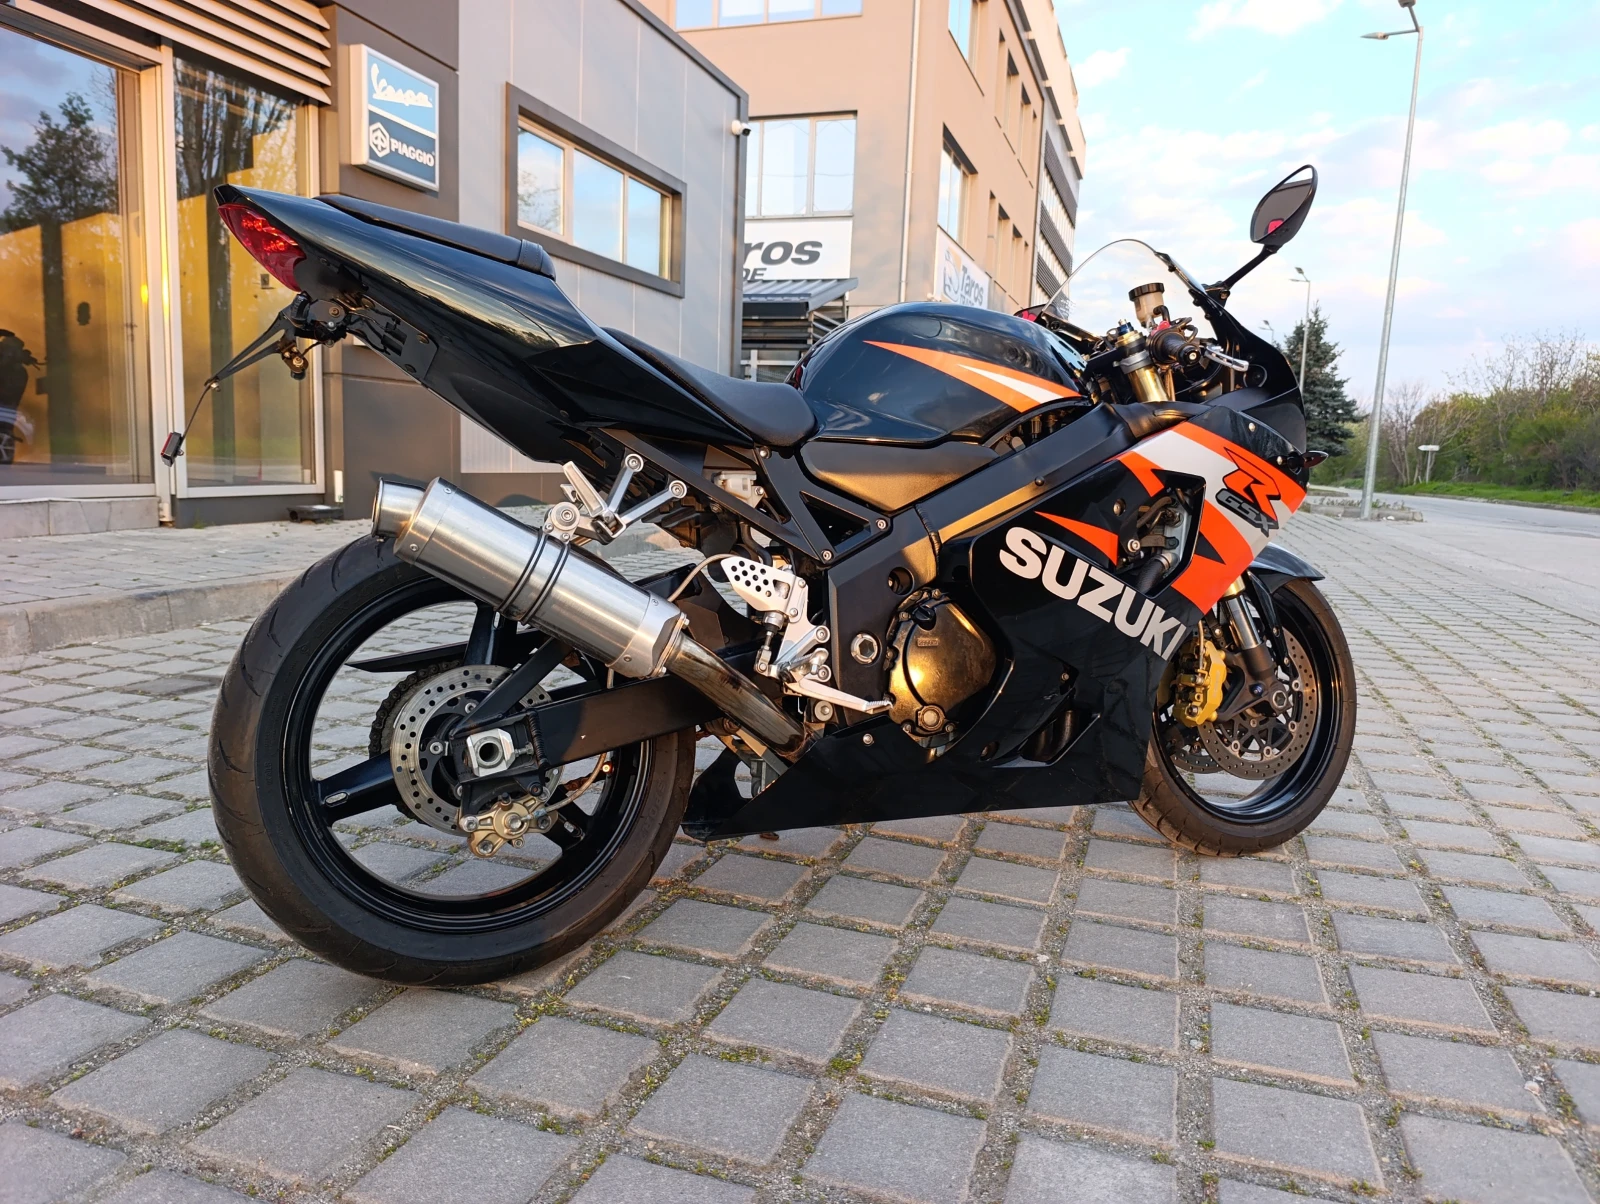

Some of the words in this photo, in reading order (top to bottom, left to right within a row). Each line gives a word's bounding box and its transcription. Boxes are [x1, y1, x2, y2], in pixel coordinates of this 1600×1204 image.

[370, 62, 434, 108] Vespa
[390, 137, 435, 167] PIAGGIO
[961, 265, 984, 307] Taros
[999, 526, 1187, 661] SUZUKI
